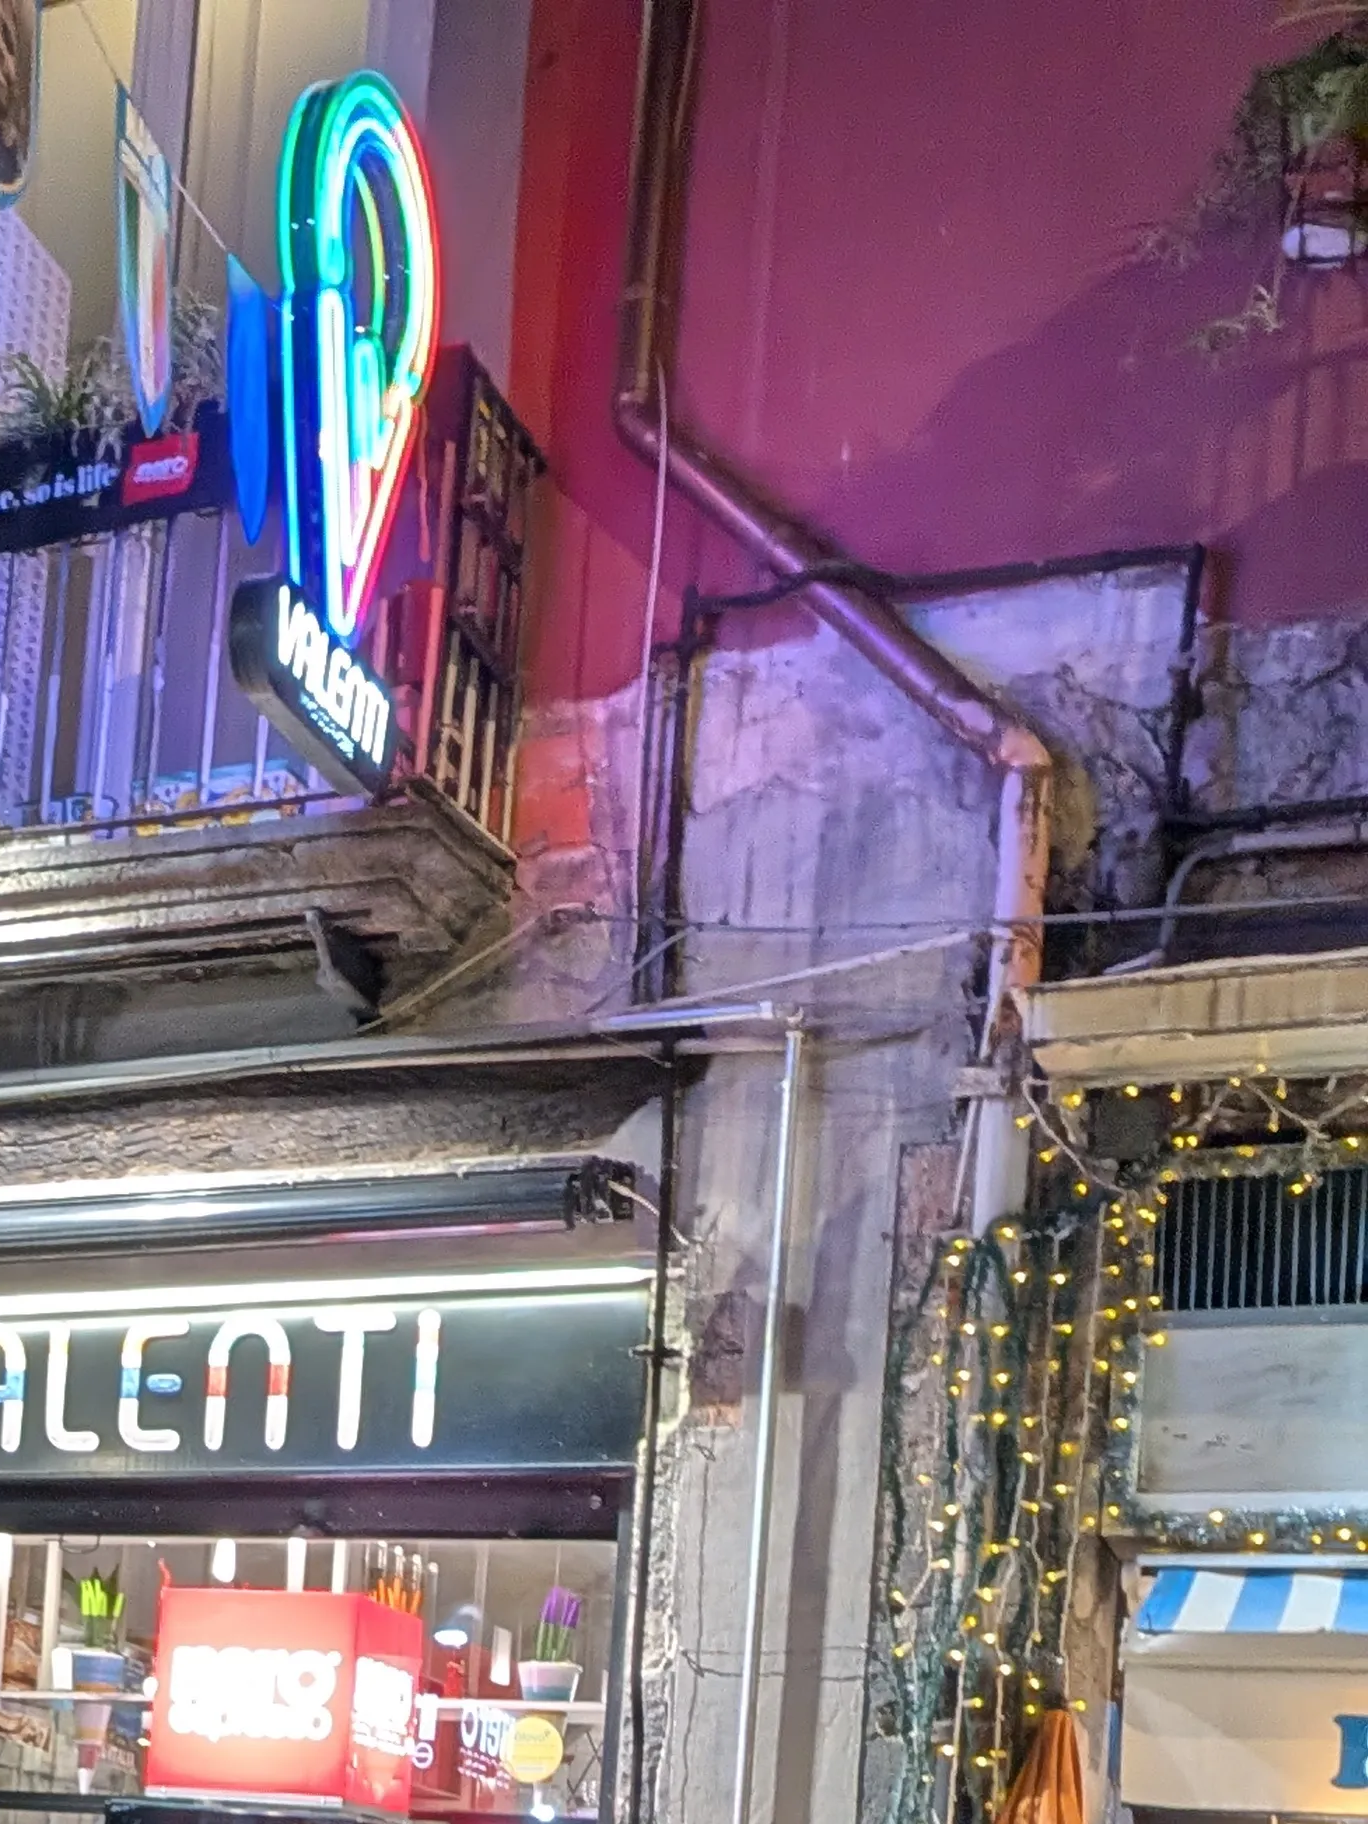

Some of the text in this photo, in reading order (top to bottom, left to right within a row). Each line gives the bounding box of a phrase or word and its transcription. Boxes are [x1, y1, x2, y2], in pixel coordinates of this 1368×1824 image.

[23, 484, 51, 505] so
[54, 472, 75, 498] is
[77, 462, 120, 495] life
[278, 584, 390, 765] VALENTI
